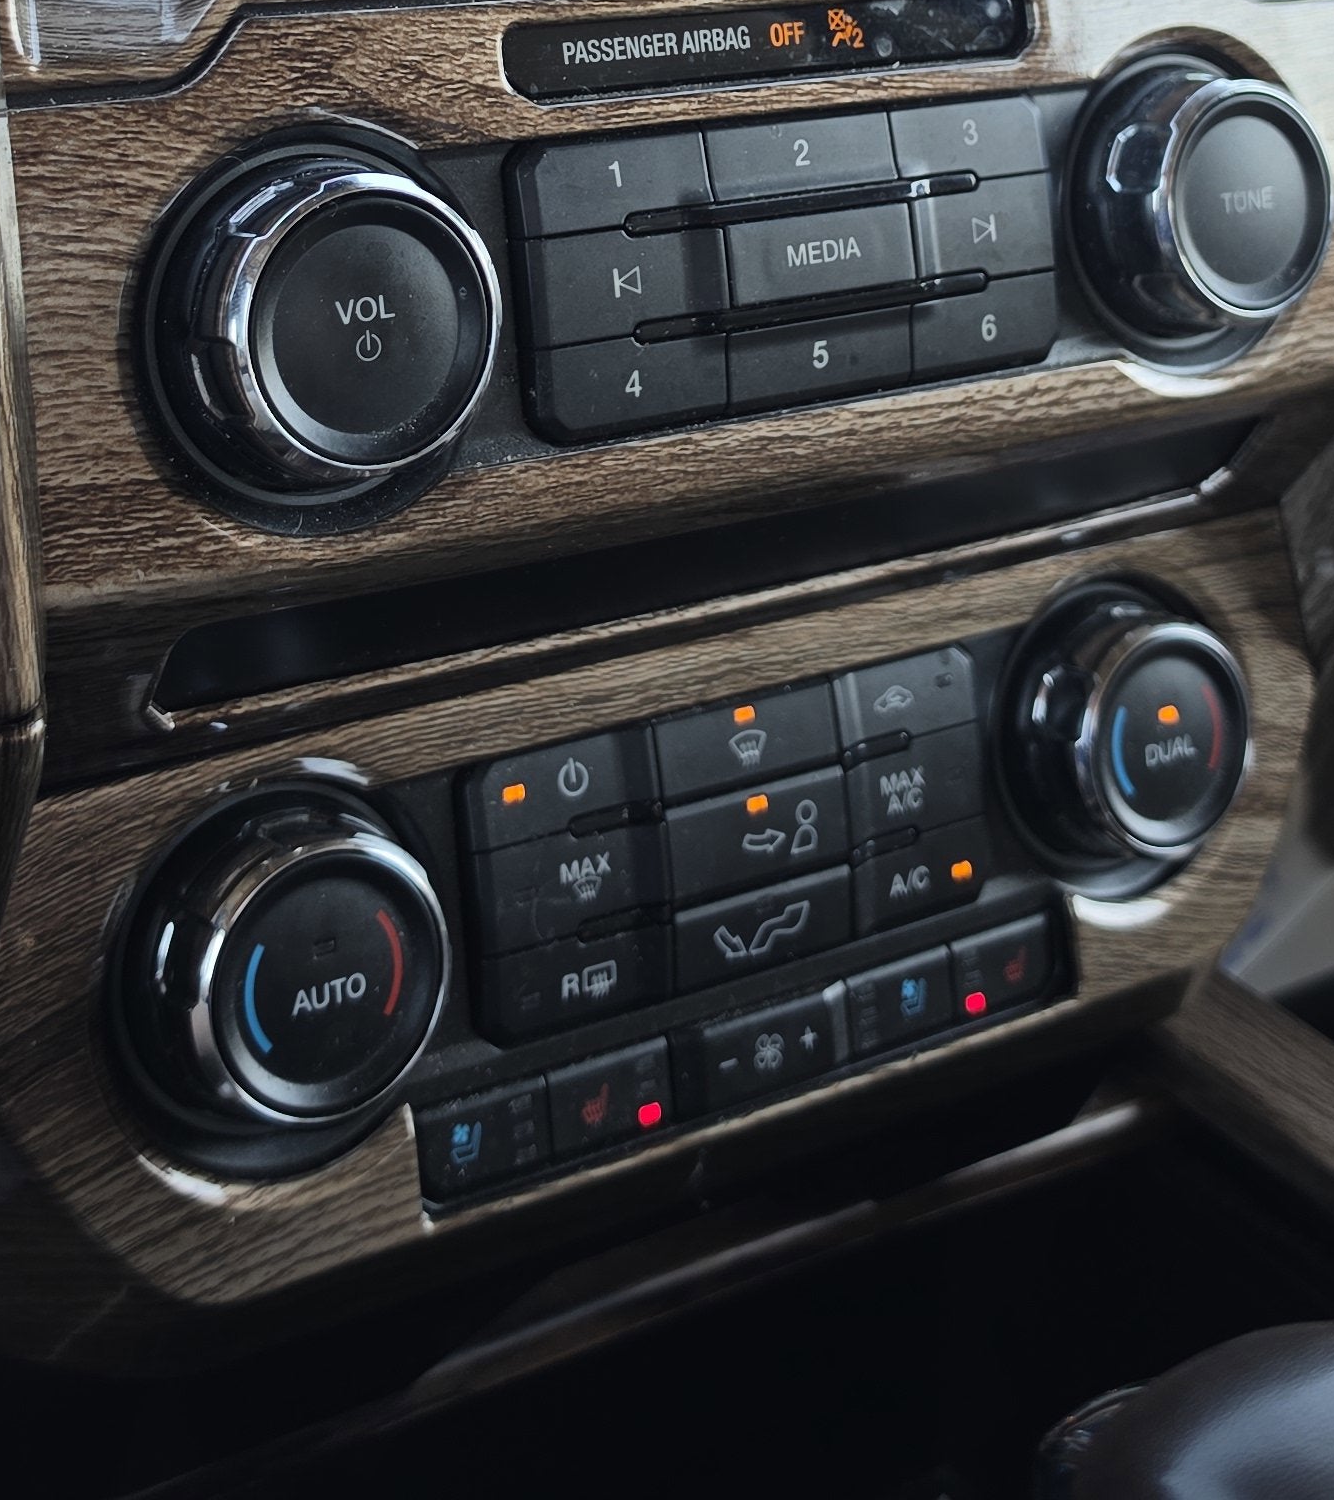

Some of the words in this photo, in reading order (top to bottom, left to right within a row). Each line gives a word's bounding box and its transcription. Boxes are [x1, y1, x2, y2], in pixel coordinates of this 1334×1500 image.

[562, 32, 679, 65] PASSENGER
[681, 25, 751, 55] AIRBAG
[770, 21, 805, 48] OFF
[961, 118, 979, 146] 3
[793, 138, 811, 168] 2
[608, 160, 623, 187] 1
[1220, 185, 1275, 214] TONE
[786, 236, 862, 268] MEDIA
[335, 295, 396, 325] VOL
[980, 313, 998, 342] 6
[811, 339, 830, 369] 5
[624, 370, 642, 397] 4
[1144, 733, 1198, 768] DUAL
[879, 766, 926, 797] MAX
[887, 787, 925, 816] A/C
[559, 851, 612, 884] MAX
[889, 865, 931, 899] A/C
[291, 972, 367, 1017] AUTO
